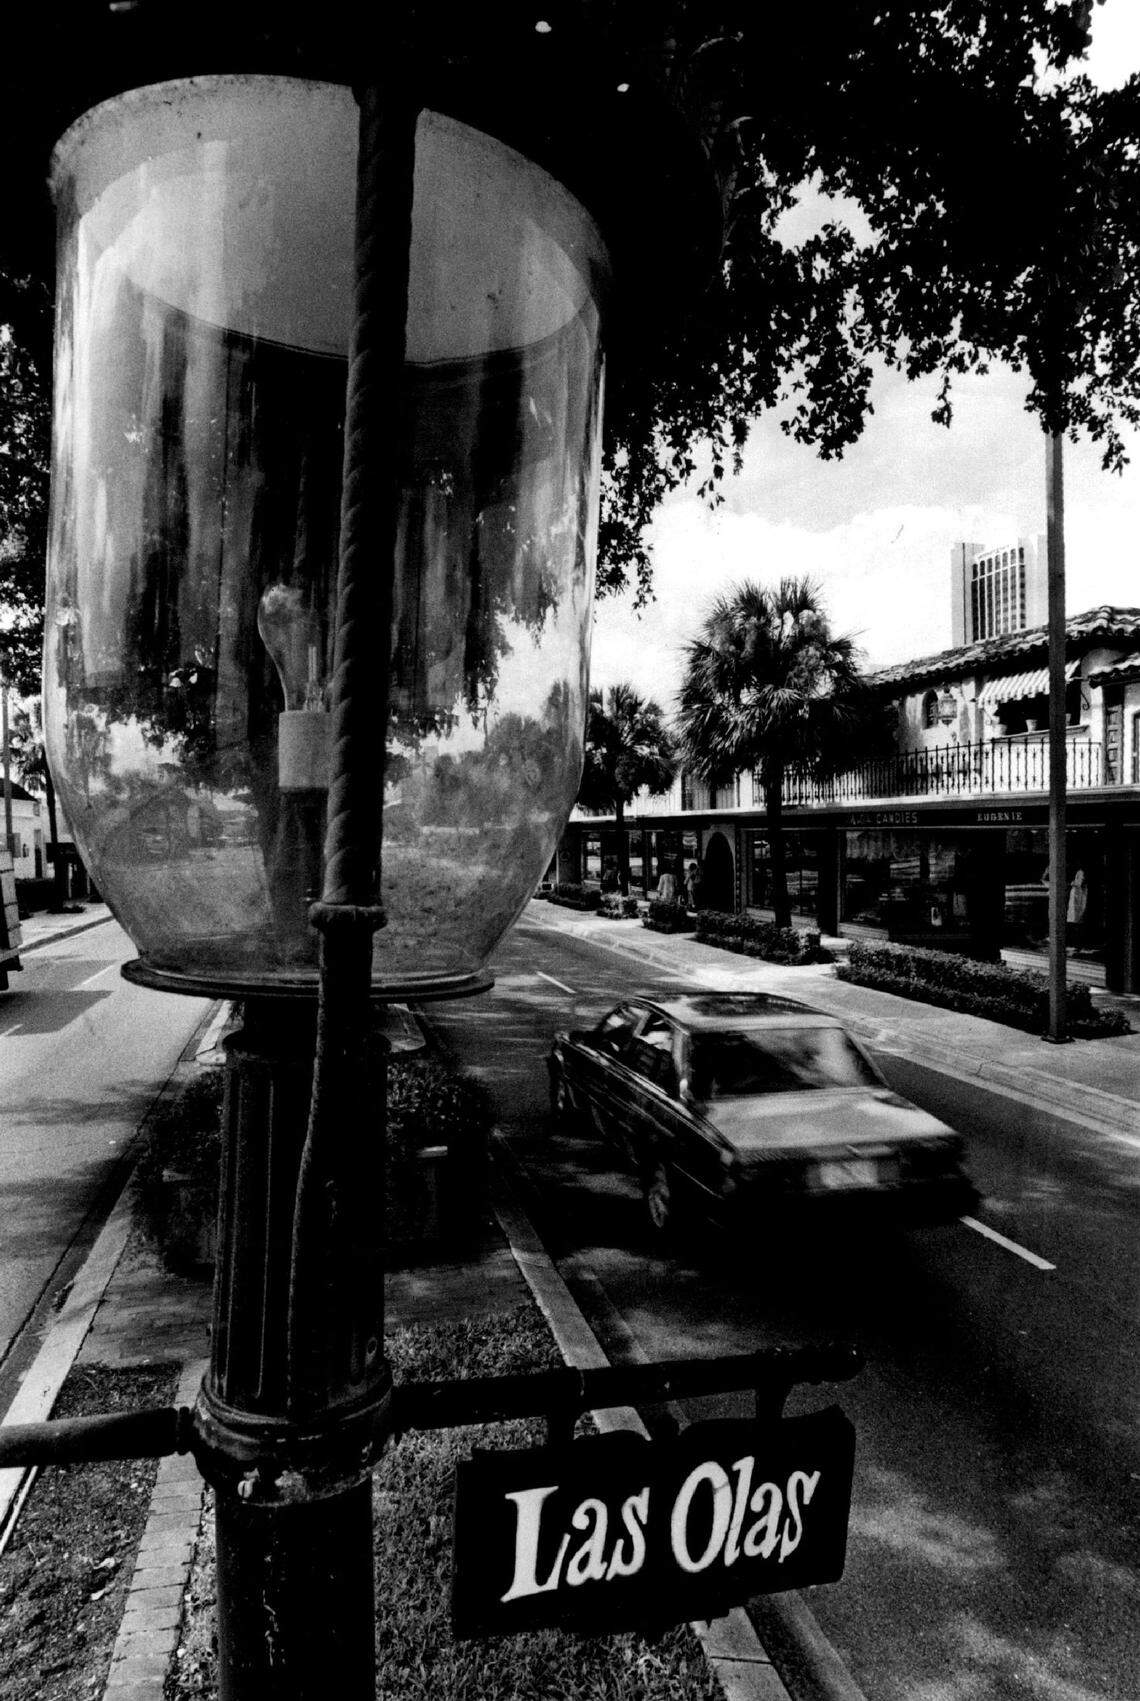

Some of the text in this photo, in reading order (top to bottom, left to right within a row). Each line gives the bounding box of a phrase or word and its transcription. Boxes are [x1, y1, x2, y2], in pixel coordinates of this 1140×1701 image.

[876, 811, 918, 824] CANDIES
[977, 811, 1022, 821] EUGENIE
[501, 1455, 821, 1603] Las Olas
